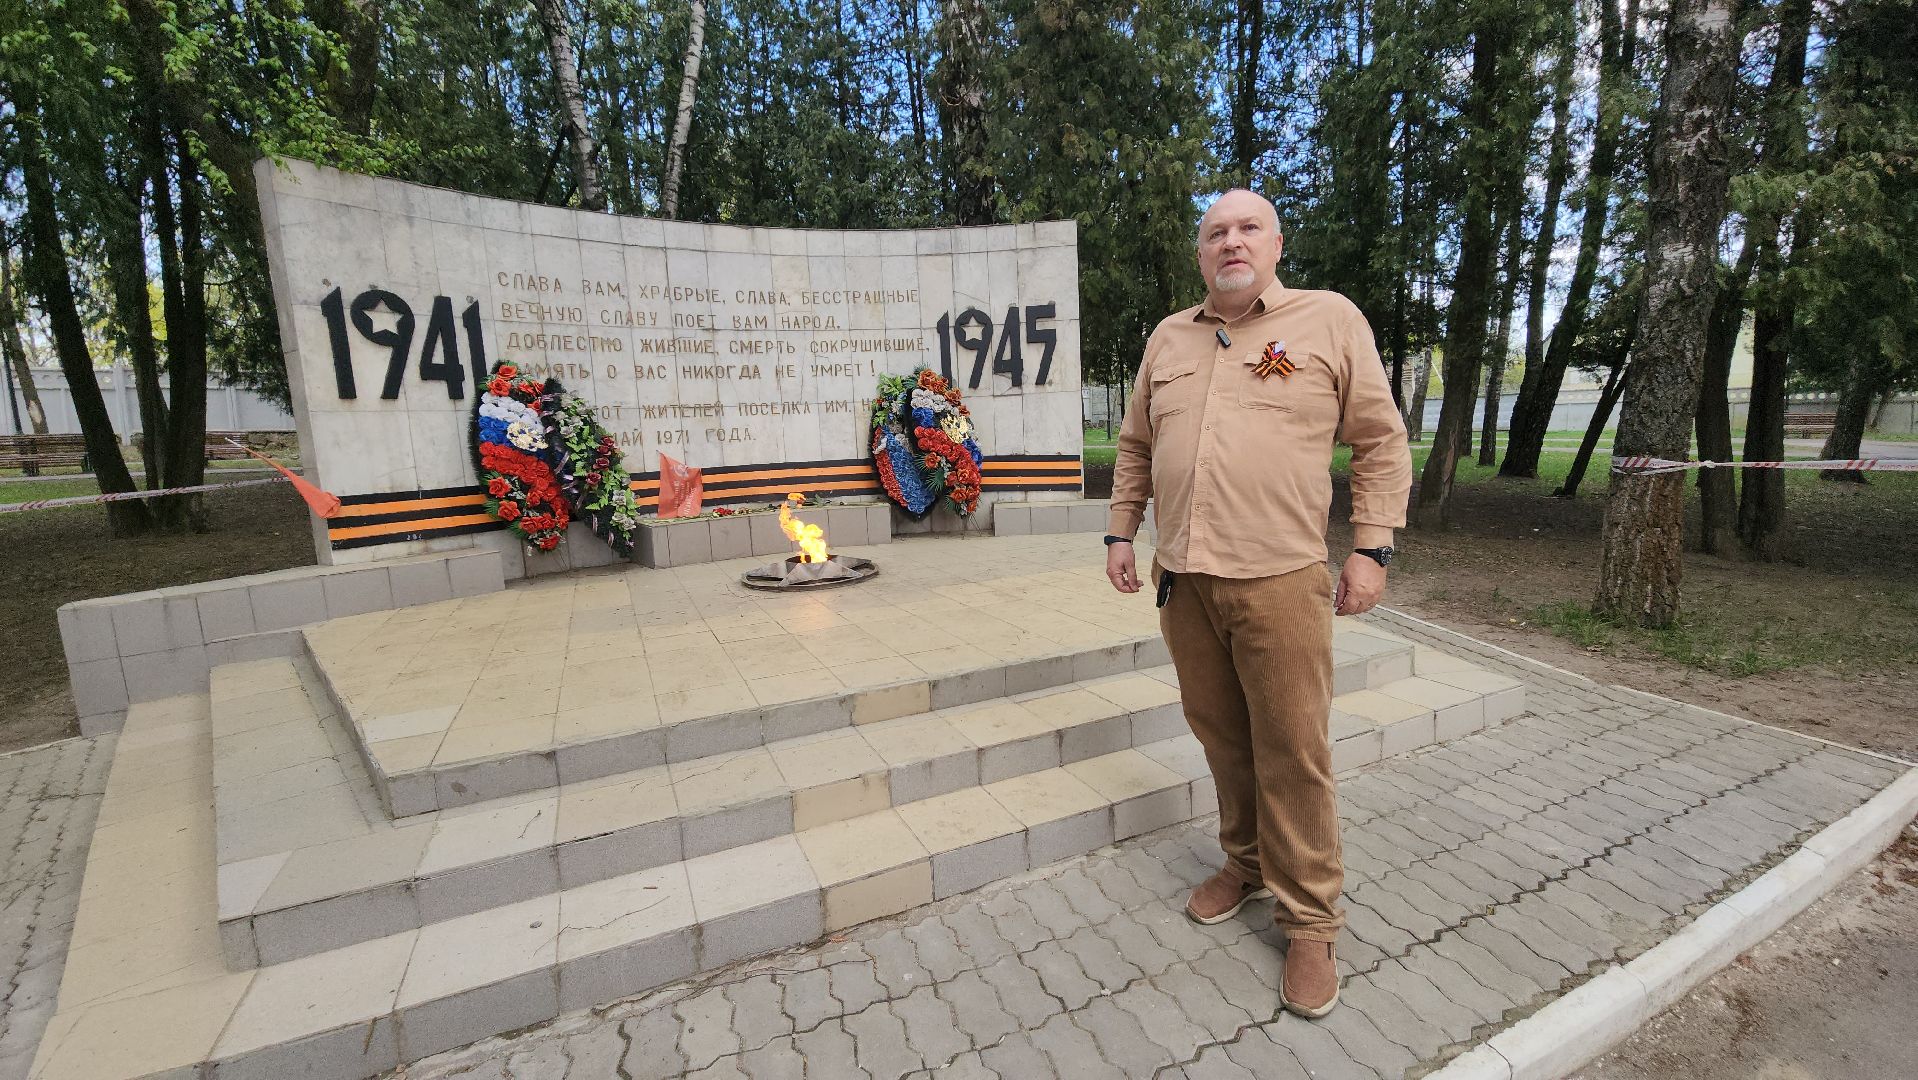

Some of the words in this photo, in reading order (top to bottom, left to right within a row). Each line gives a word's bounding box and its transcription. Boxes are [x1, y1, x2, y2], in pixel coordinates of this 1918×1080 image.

[497, 271, 563, 294] СЛАВА
[801, 289, 919, 305] БЕССТРАШНЫЕ
[501, 302, 583, 323] ВЕЧНУЮ
[600, 309, 658, 326] СЛАВУ
[674, 312, 717, 330] ПОЕТ
[732, 315, 768, 329] ВАМ
[320, 286, 490, 400] 1941
[507, 332, 623, 353] ДОБЛЕСТНО
[729, 340, 796, 354] СМЕРТЬ
[936, 304, 1057, 389] 1945
[522, 362, 592, 380] АМЯТЬ
[606, 364, 618, 379] О
[634, 364, 667, 380] ВАС
[682, 364, 761, 380] НИКОГДА
[775, 364, 796, 379] НЕ
[601, 405, 623, 420] ОТ
[642, 400, 725, 419] ЖИТЕЛЕЙ
[738, 401, 811, 417] ПОСЕЛКА
[824, 399, 852, 414] ИМ.
[656, 429, 690, 446] 1971
[705, 427, 757, 444] ГОДА.
